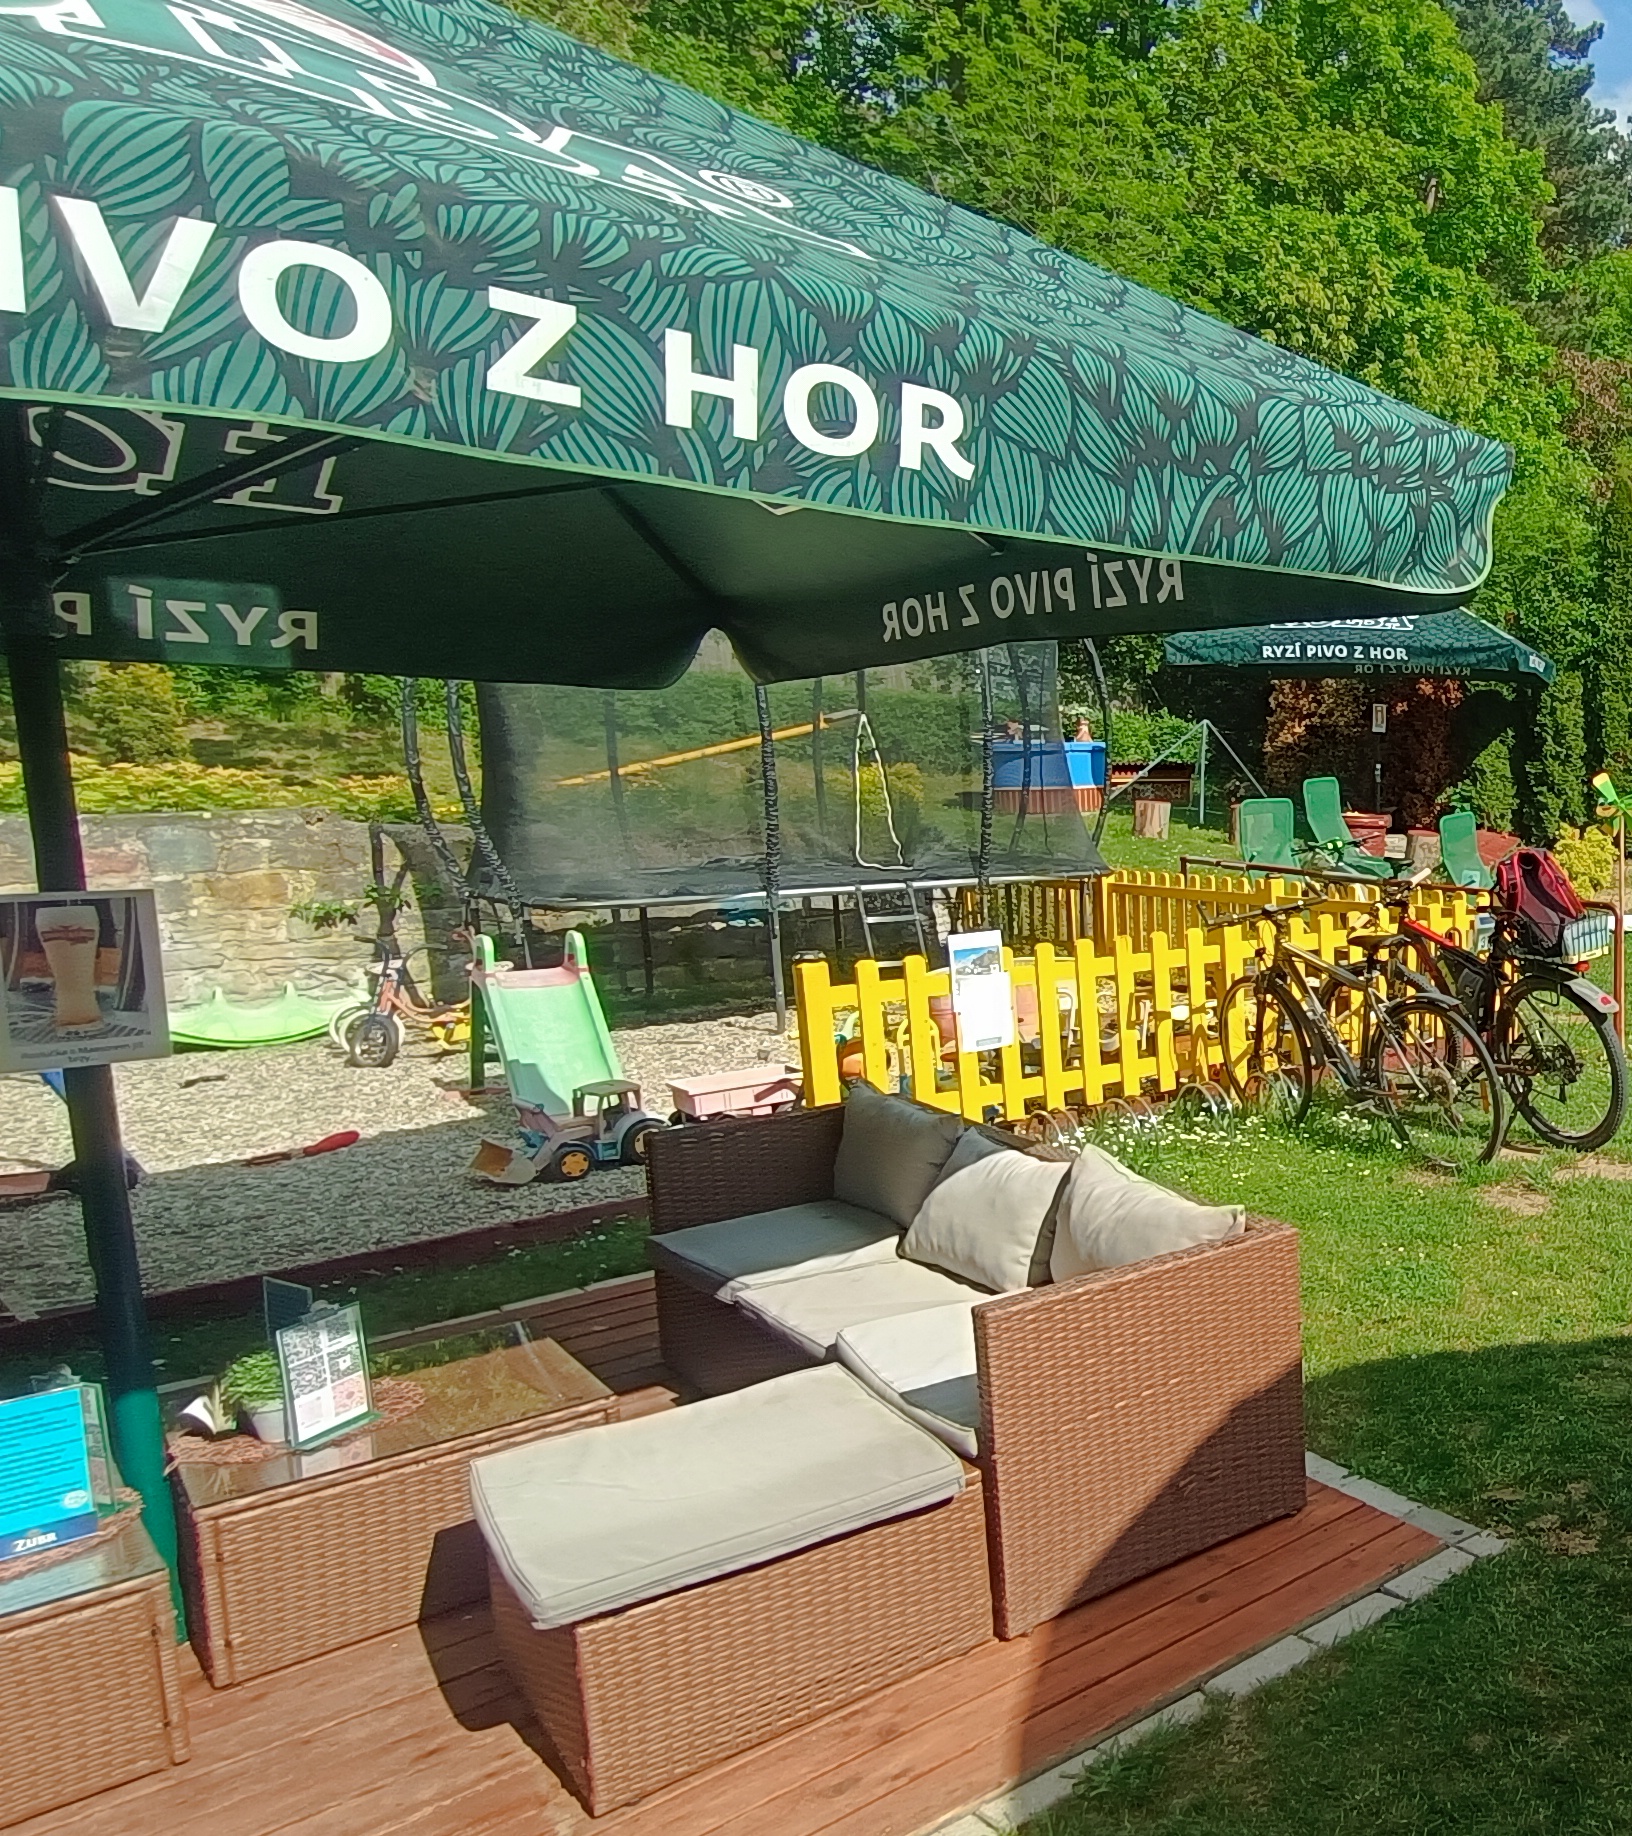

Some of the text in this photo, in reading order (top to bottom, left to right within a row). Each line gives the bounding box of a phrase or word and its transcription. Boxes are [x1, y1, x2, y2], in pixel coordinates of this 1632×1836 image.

[486, 285, 582, 408] Z
[664, 328, 976, 481] HOR
[1262, 642, 1409, 661] RYZÍ PIVO Z HOR
